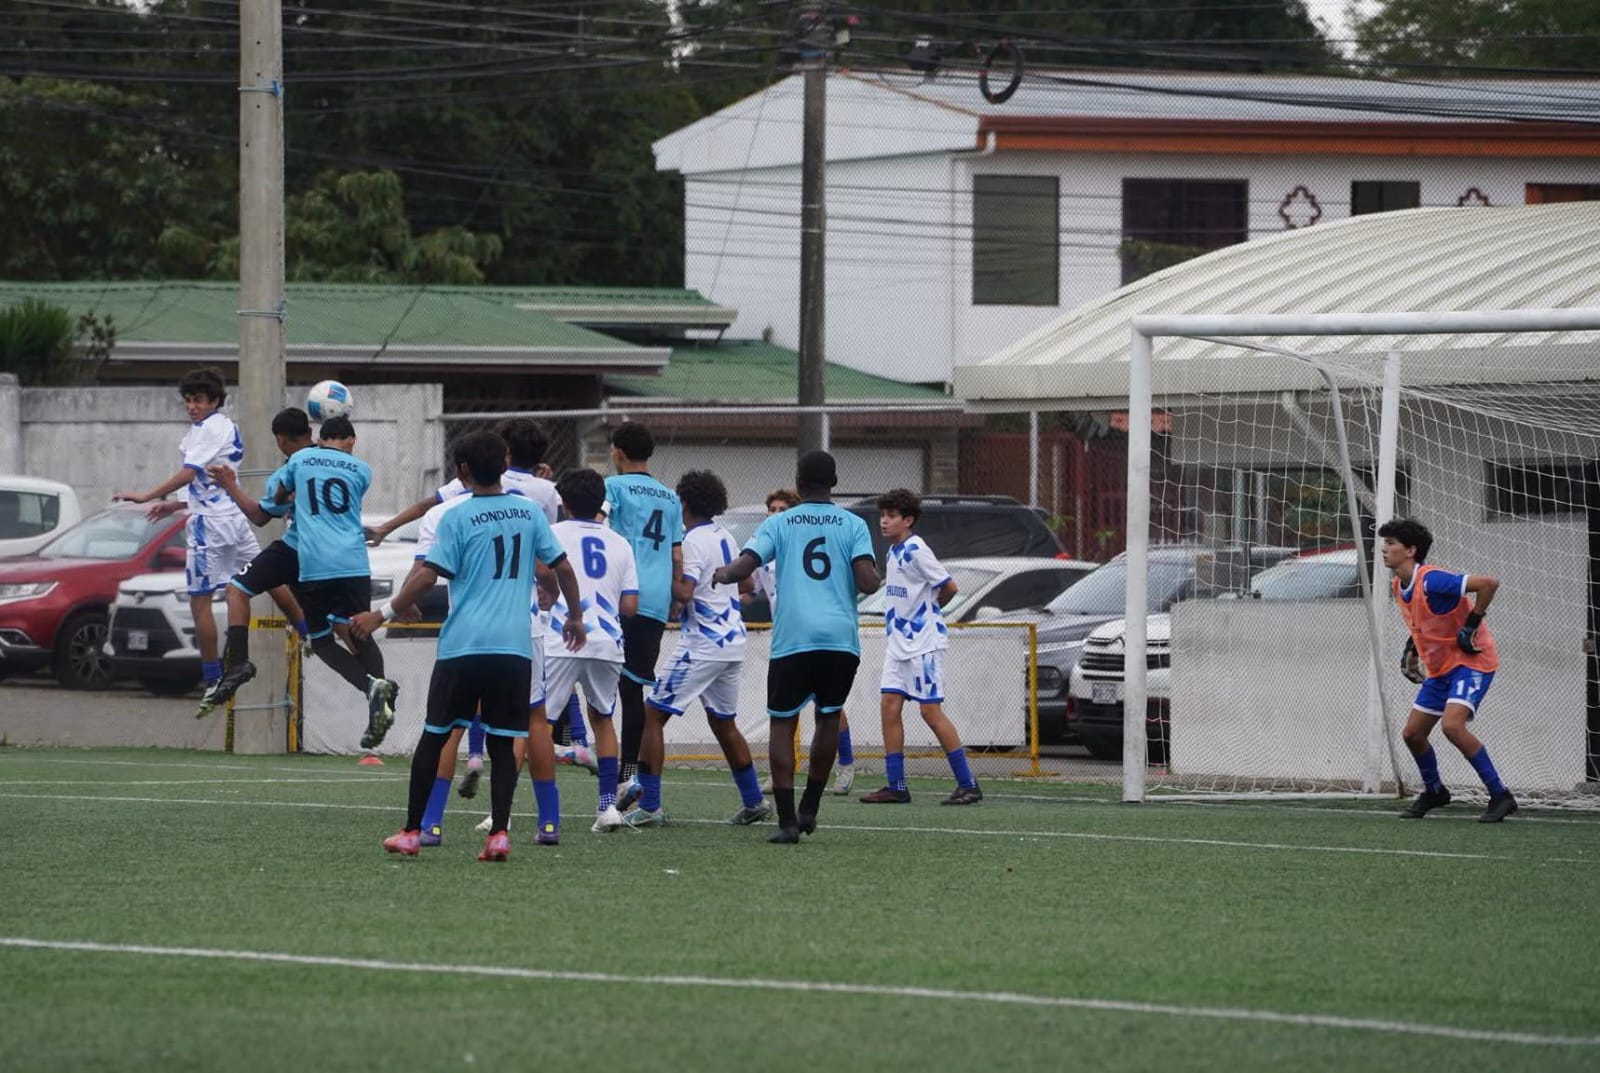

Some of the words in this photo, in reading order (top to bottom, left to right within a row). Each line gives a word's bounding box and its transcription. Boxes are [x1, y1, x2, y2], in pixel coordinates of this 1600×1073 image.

[302, 457, 358, 472] HONDURAS
[307, 477, 350, 515] 10
[470, 508, 532, 526] HONDURAS
[642, 509, 666, 552] 4
[787, 514, 843, 526] HONDURAS
[493, 532, 521, 579] 11
[581, 536, 607, 579] 6
[802, 536, 832, 581] 6
